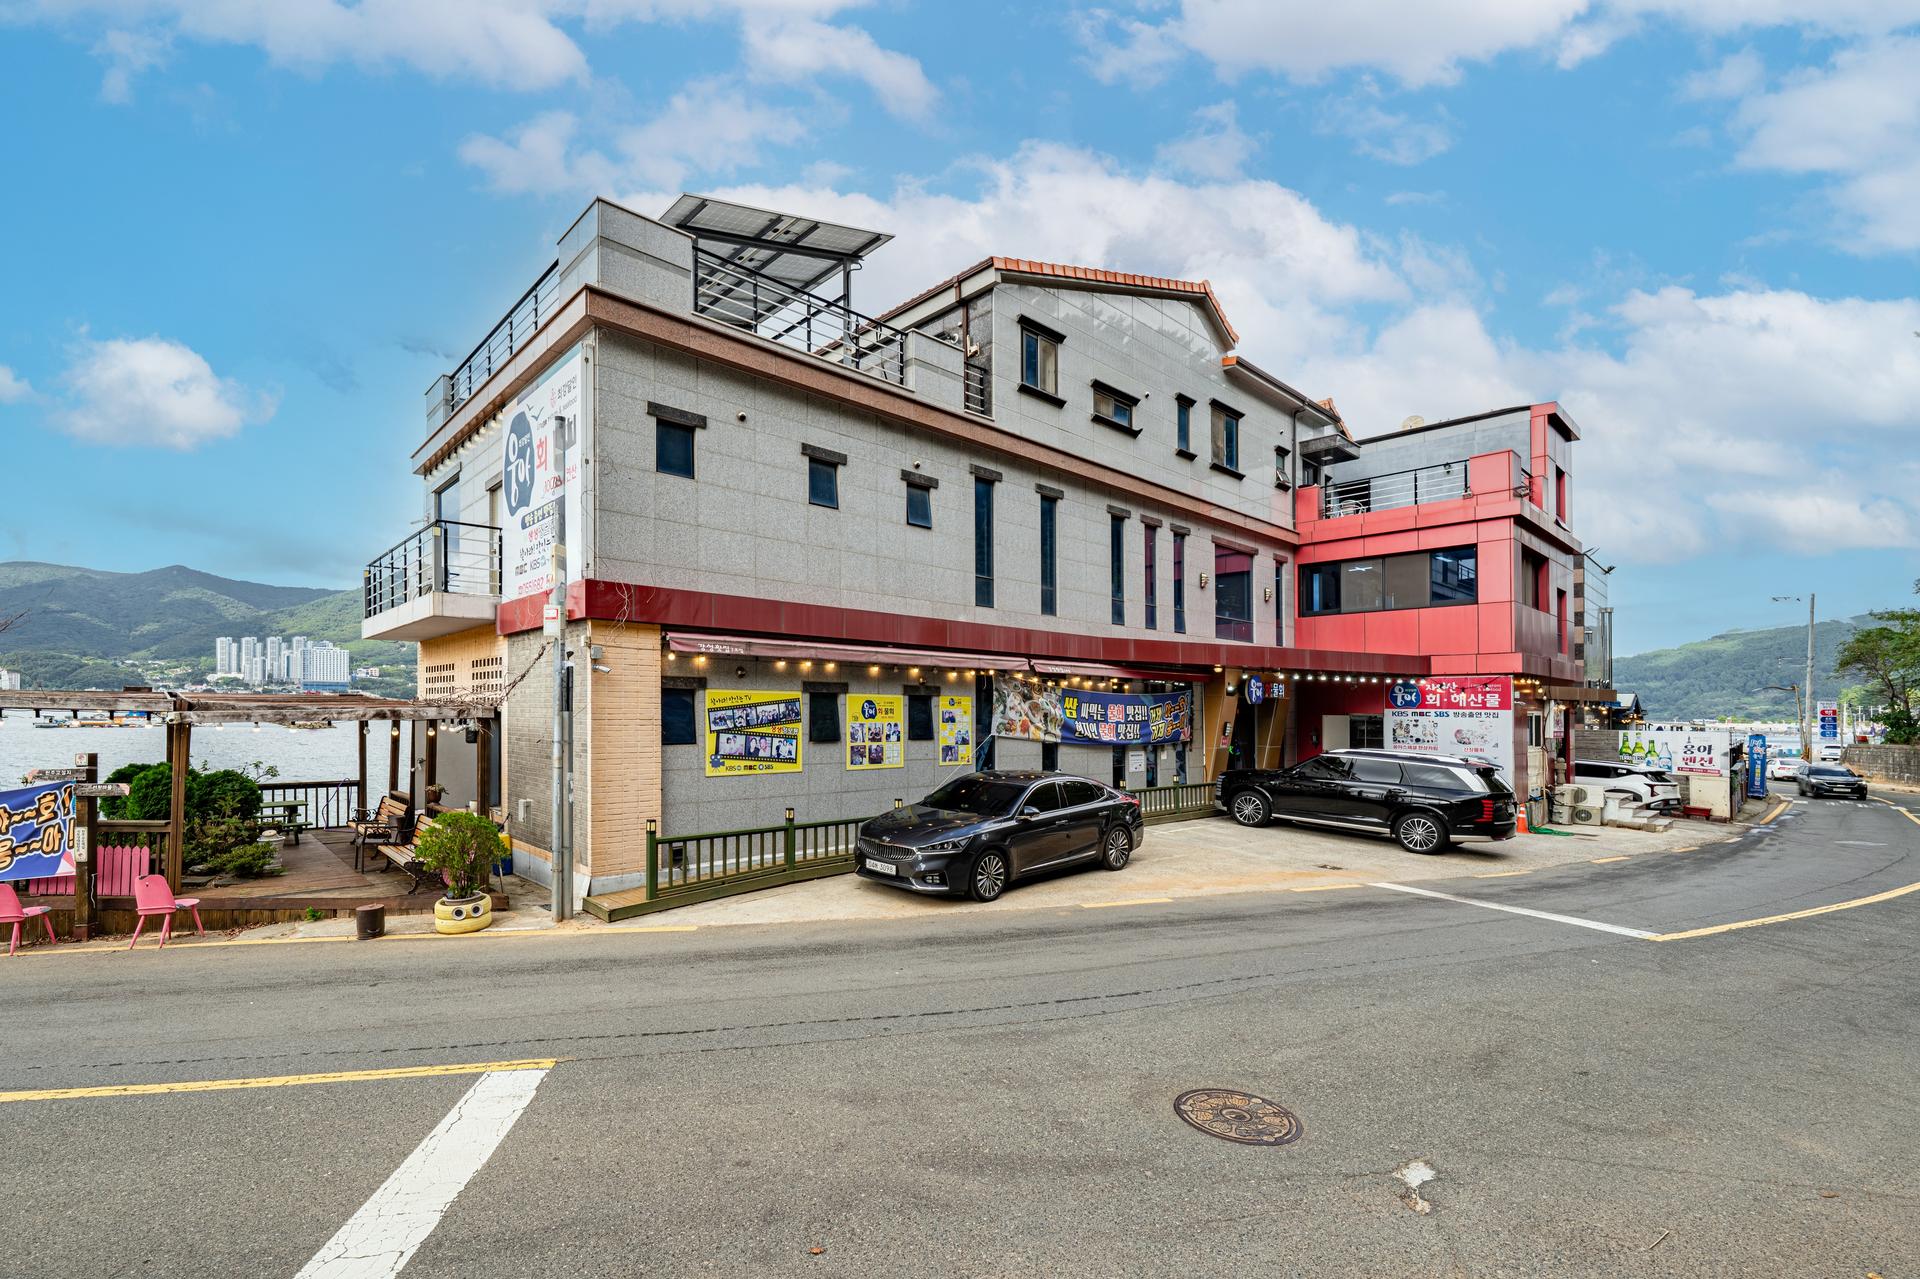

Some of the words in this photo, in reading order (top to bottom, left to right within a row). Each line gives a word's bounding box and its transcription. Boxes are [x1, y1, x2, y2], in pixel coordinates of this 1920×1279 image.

[536, 435, 548, 472] 회
[507, 432, 531, 508] 웅아
[1250, 679, 1263, 702] 웅아
[1392, 686, 1417, 706] 웅아
[863, 702, 876, 718] 웅아
[1108, 704, 1125, 722] 물회
[1126, 704, 1148, 721] 맛집!!
[1075, 721, 1098, 737] 현지인
[1099, 723, 1117, 740] 물회
[1117, 723, 1140, 740] 맛집!!
